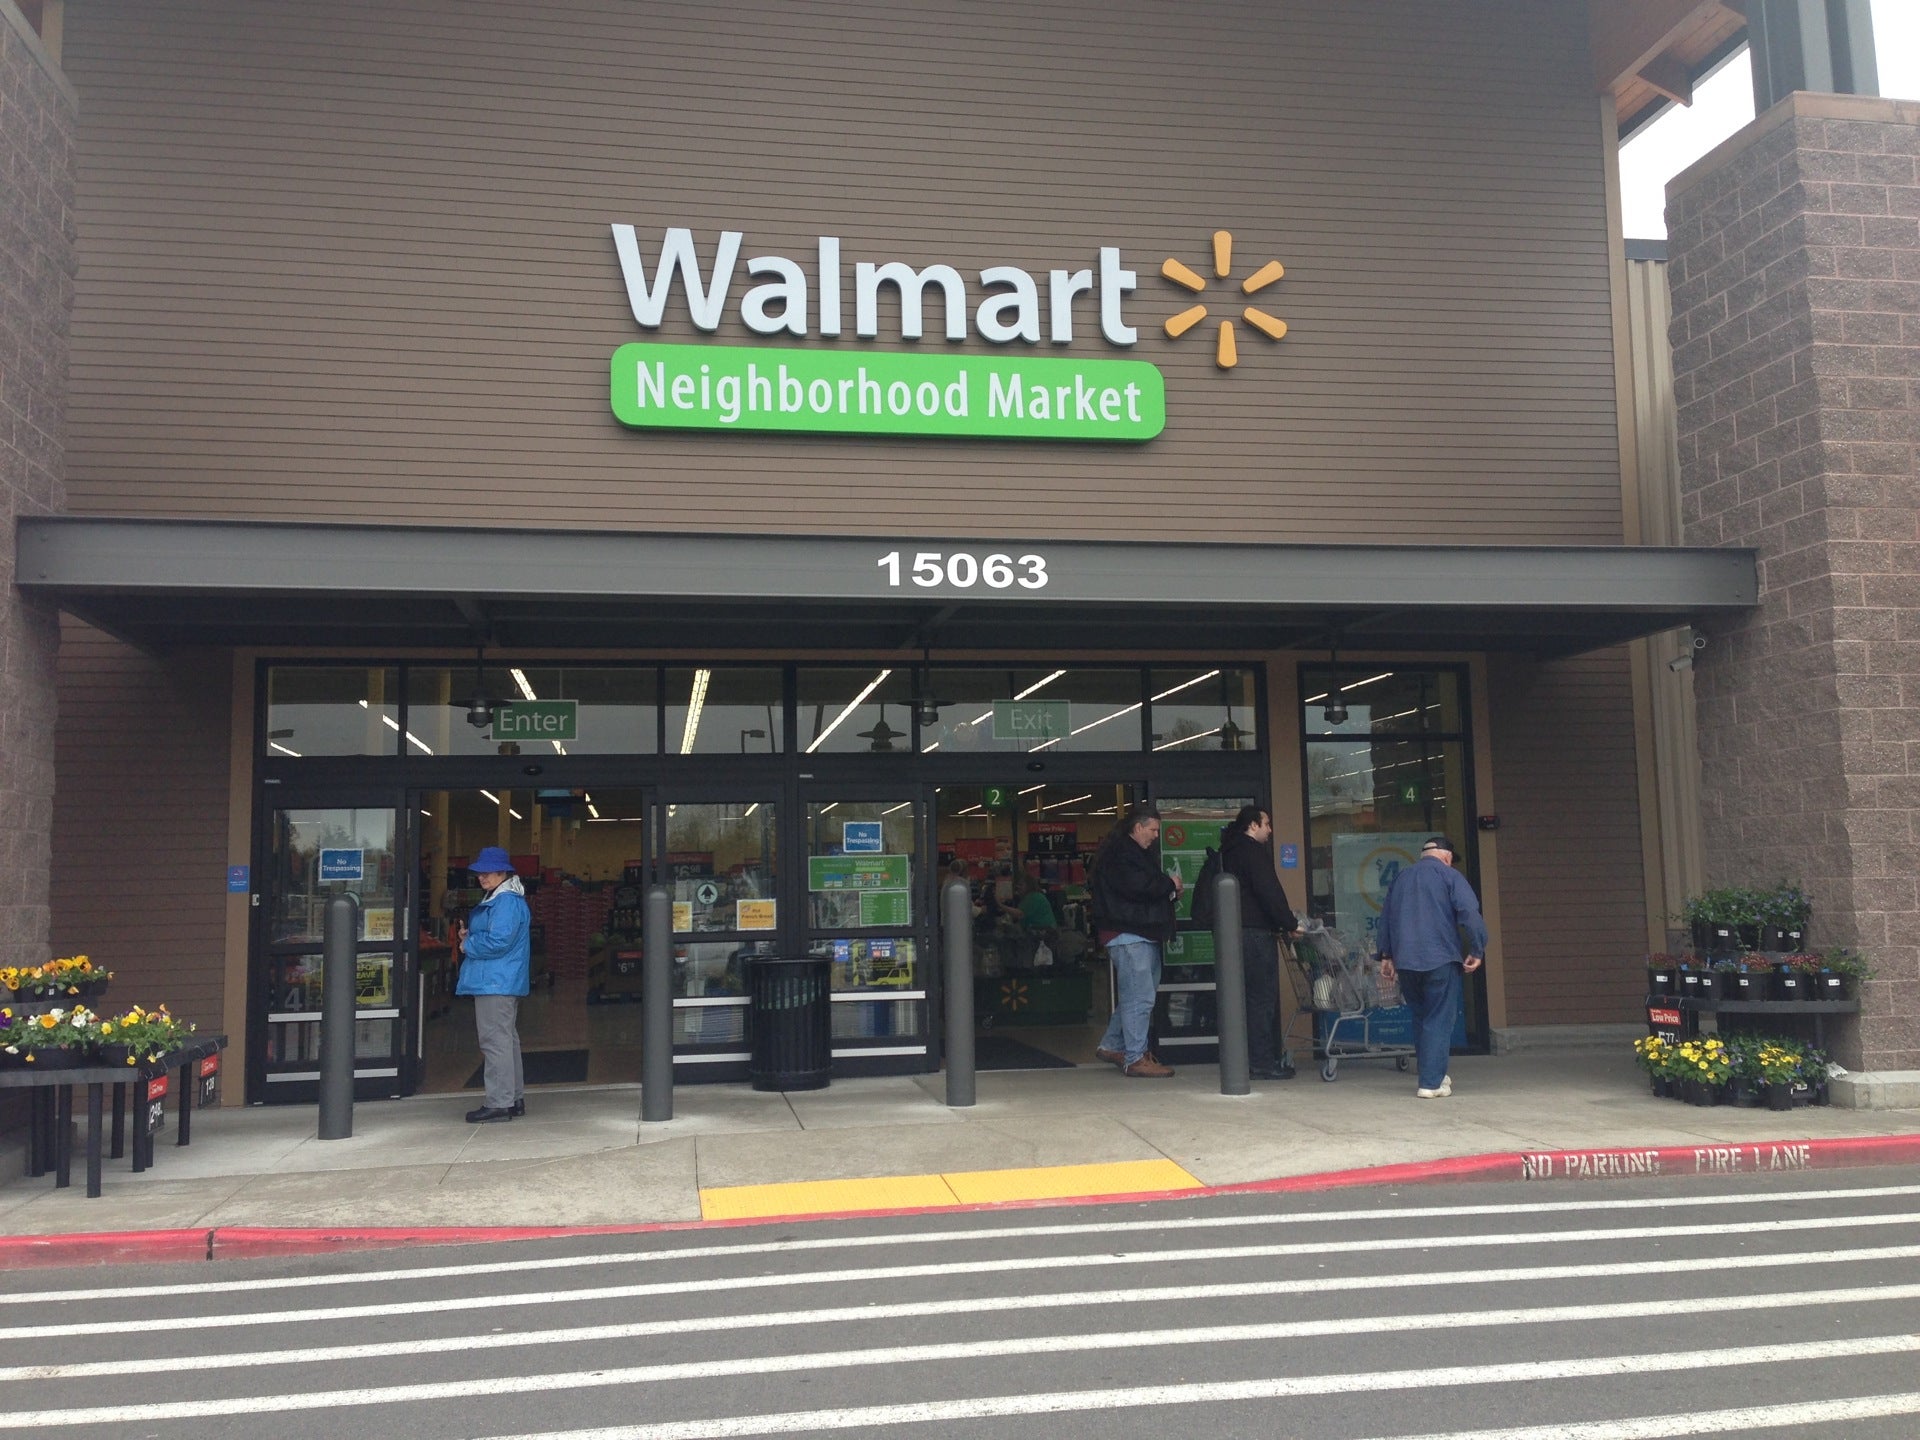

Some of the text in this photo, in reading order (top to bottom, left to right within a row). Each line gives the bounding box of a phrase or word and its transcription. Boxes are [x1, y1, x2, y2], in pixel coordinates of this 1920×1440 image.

[610, 223, 1137, 347] Walmart
[636, 360, 1142, 423] Neighborhood Market
[877, 551, 1049, 590] 15063
[499, 708, 569, 732] Enter
[1010, 708, 1053, 730] Exit
[991, 789, 1000, 805] 2
[1406, 787, 1415, 802] 4
[322, 864, 361, 873] Trespassing
[356, 971, 376, 979] EAVE
[1651, 1012, 1679, 1023] Low Price
[1521, 1145, 1811, 1180] NO PARKING FIRE LANE
